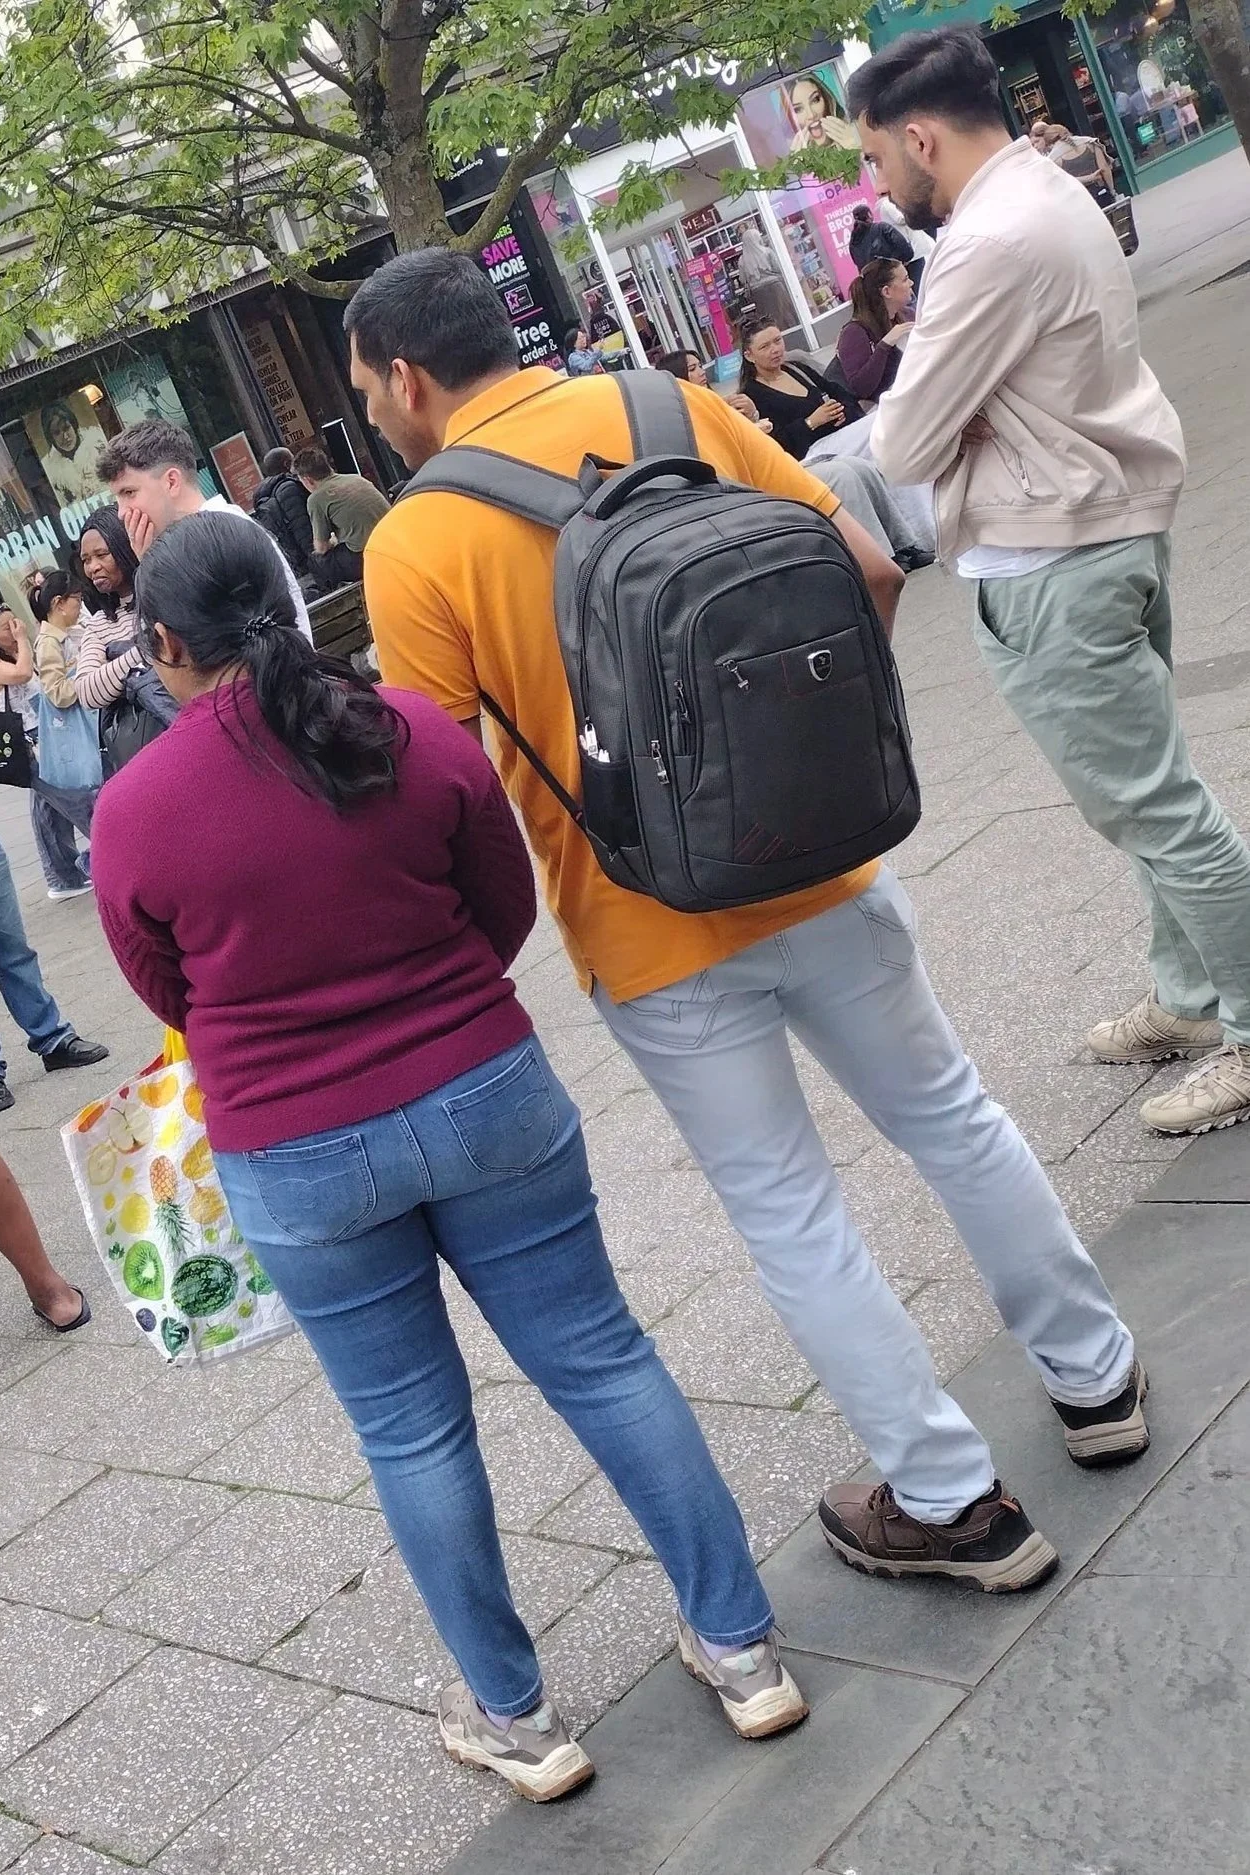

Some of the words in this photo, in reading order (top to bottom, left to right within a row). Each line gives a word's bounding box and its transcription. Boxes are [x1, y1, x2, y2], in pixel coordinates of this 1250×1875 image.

[482, 235, 522, 267] SAVE
[488, 255, 527, 284] MORE
[513, 321, 551, 349] free
[522, 344, 548, 364] order
[548, 338, 559, 351] &
